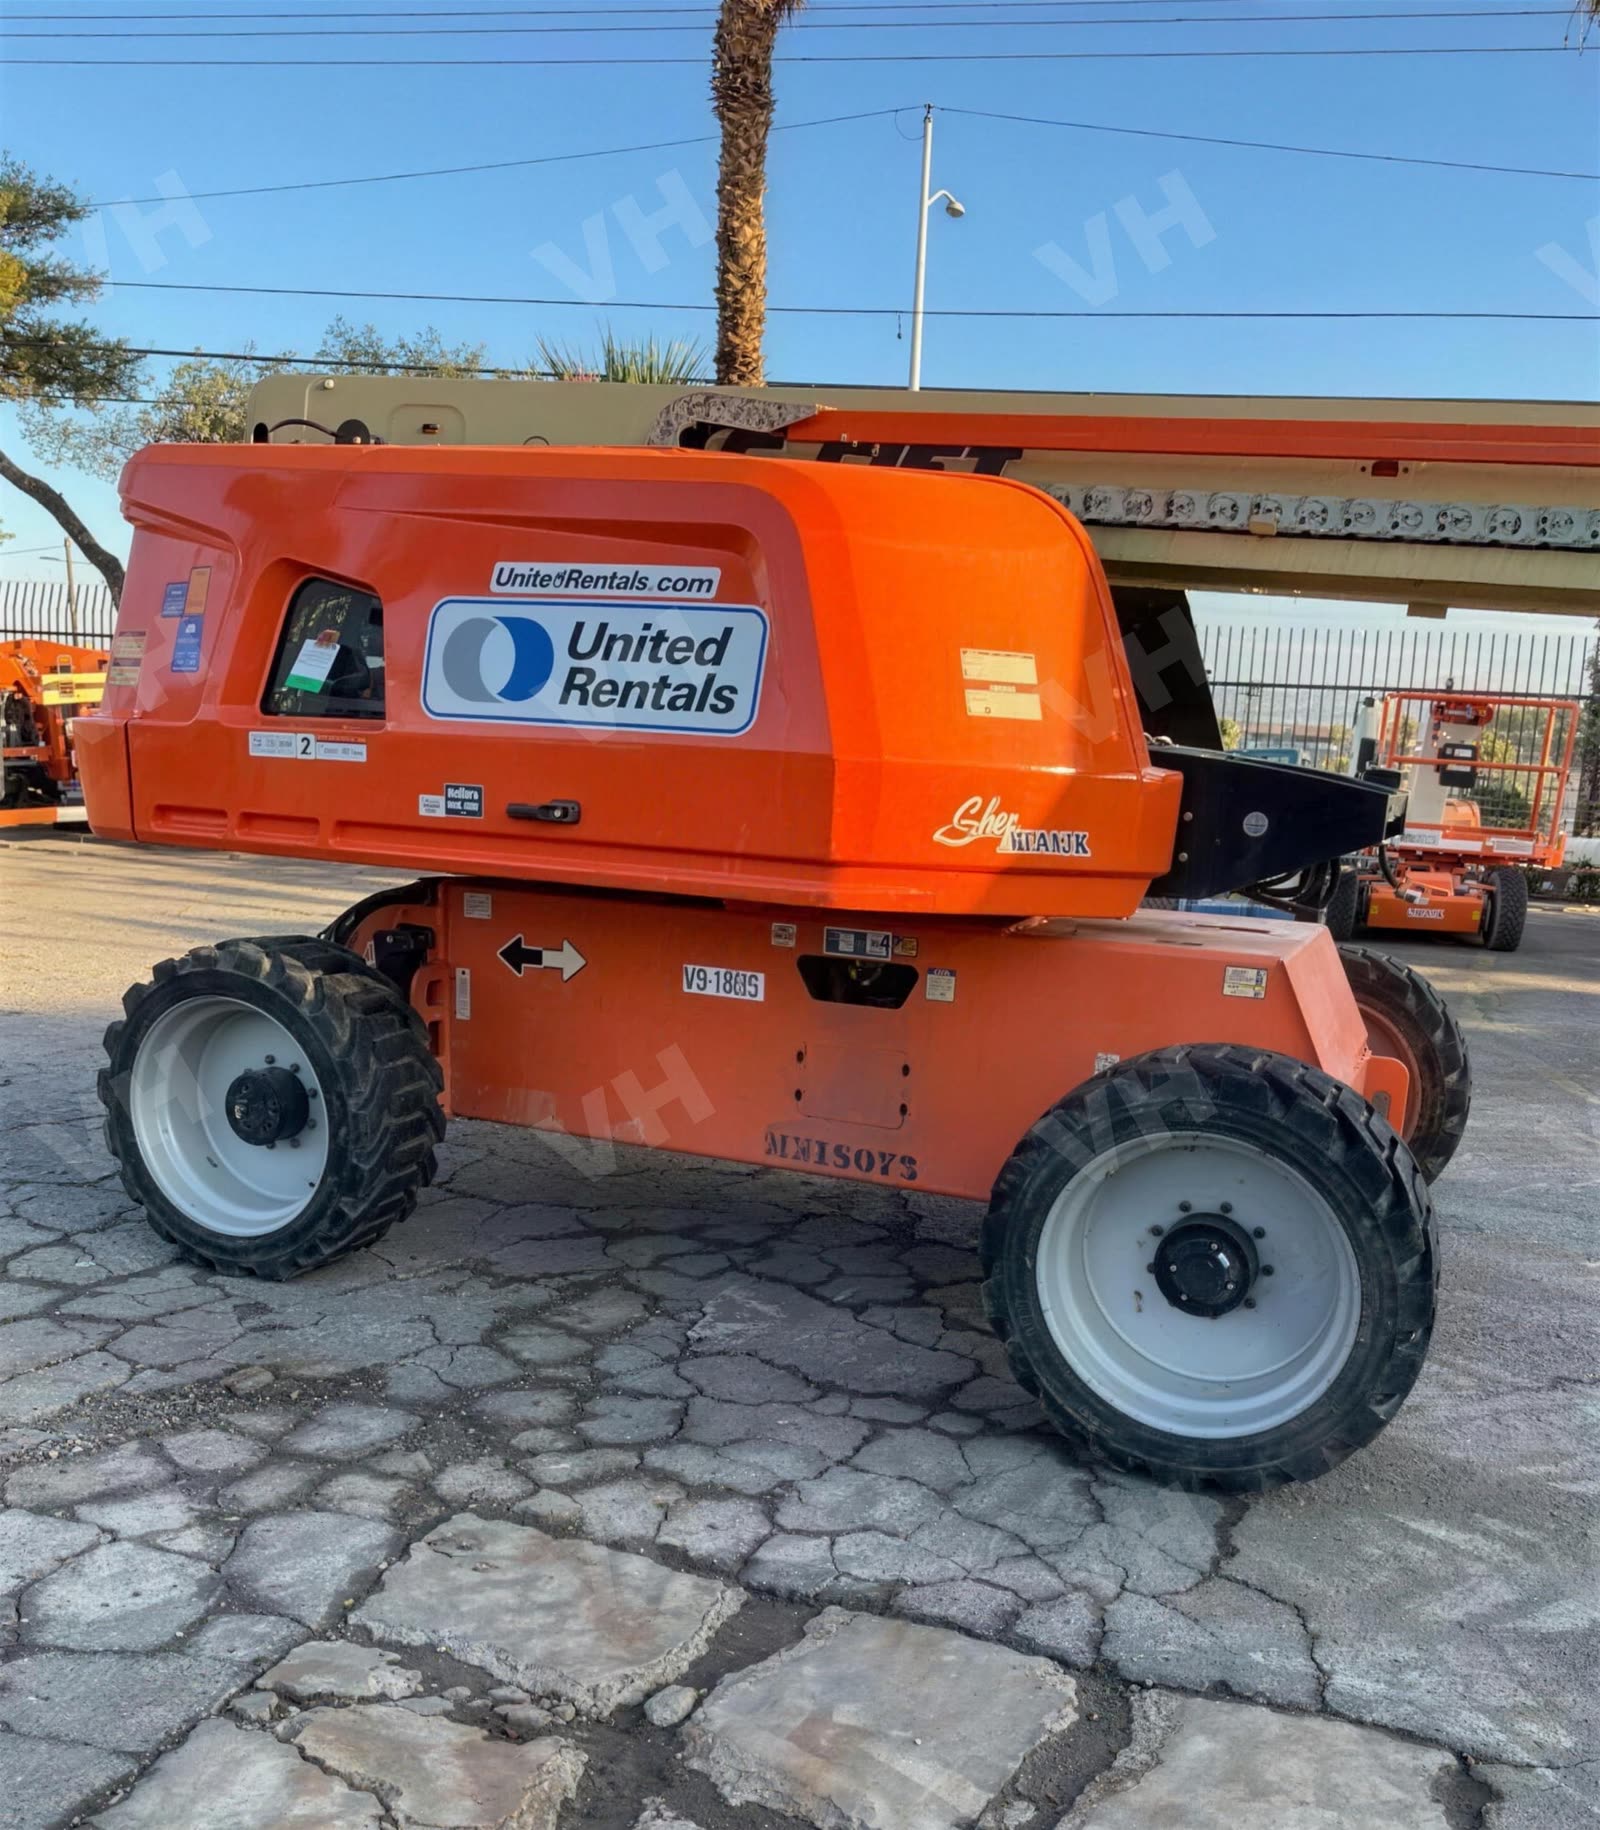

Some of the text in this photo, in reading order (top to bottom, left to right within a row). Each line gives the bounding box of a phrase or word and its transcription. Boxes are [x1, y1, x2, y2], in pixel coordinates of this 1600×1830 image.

[567, 621, 733, 667] United
[559, 666, 739, 715] Rentals
[300, 736, 312, 755] 2
